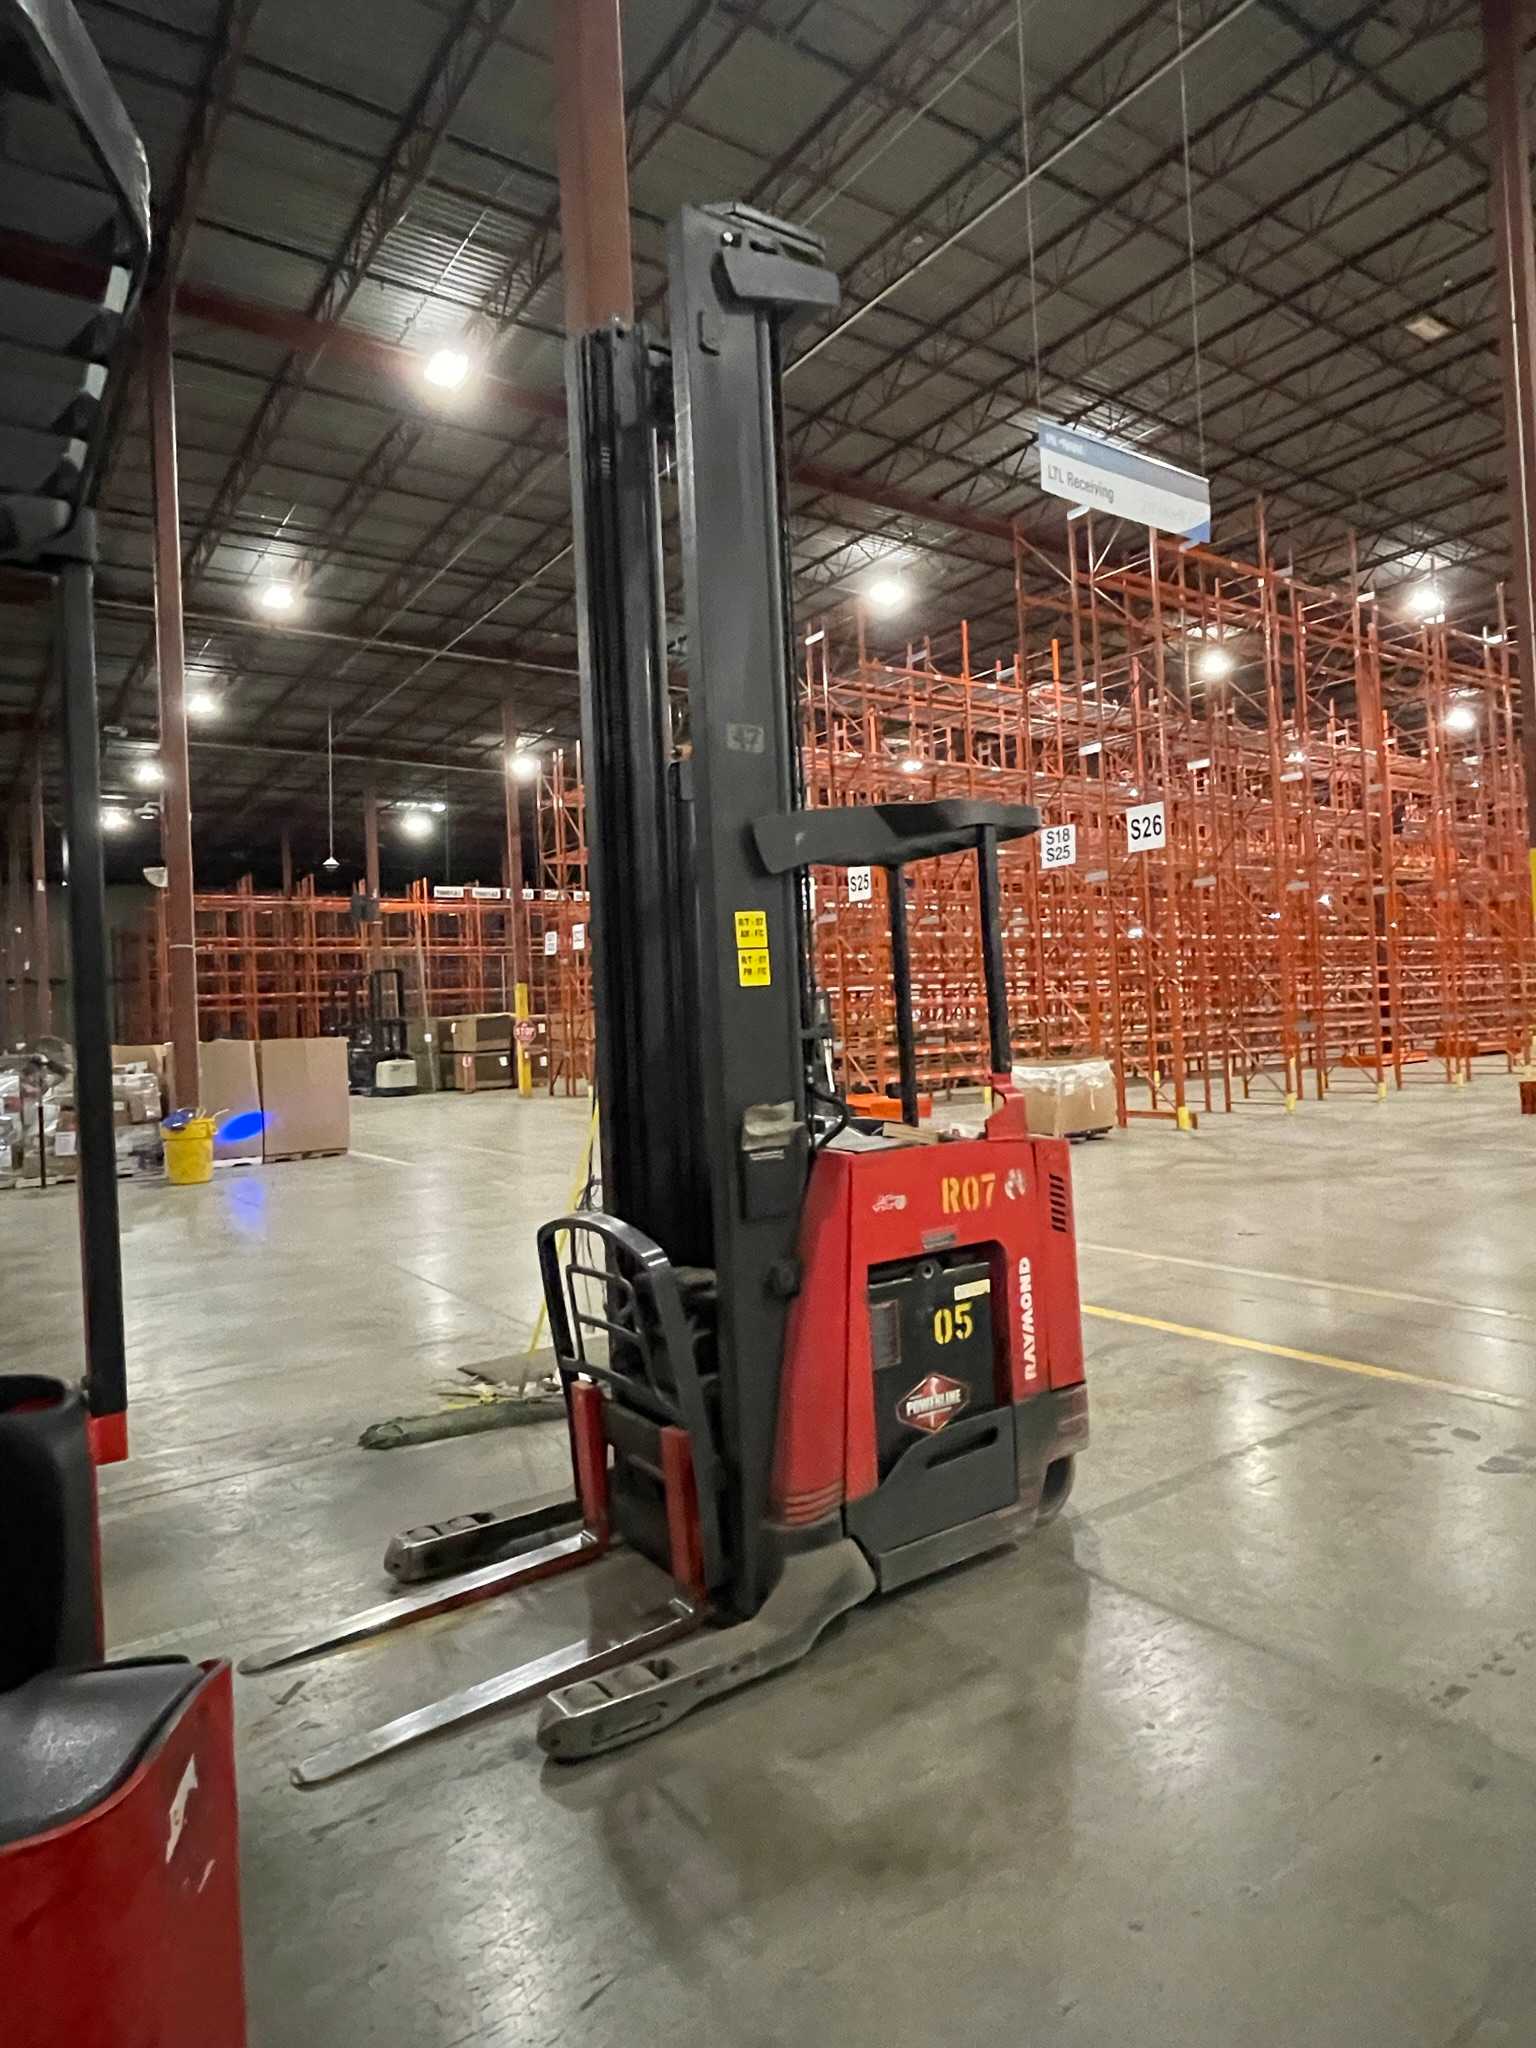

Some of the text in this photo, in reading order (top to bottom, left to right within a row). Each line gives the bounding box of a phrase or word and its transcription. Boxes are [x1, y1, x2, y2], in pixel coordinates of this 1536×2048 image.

[1047, 464, 1114, 504] LTL Receiving
[1045, 828, 1071, 845] S18
[1130, 814, 1163, 840] S26
[1045, 845, 1071, 863] S25
[849, 874, 870, 893] S25
[942, 1172, 996, 1214] R07
[933, 1302, 973, 1345] 05
[1018, 1256, 1037, 1381] RAYMOND
